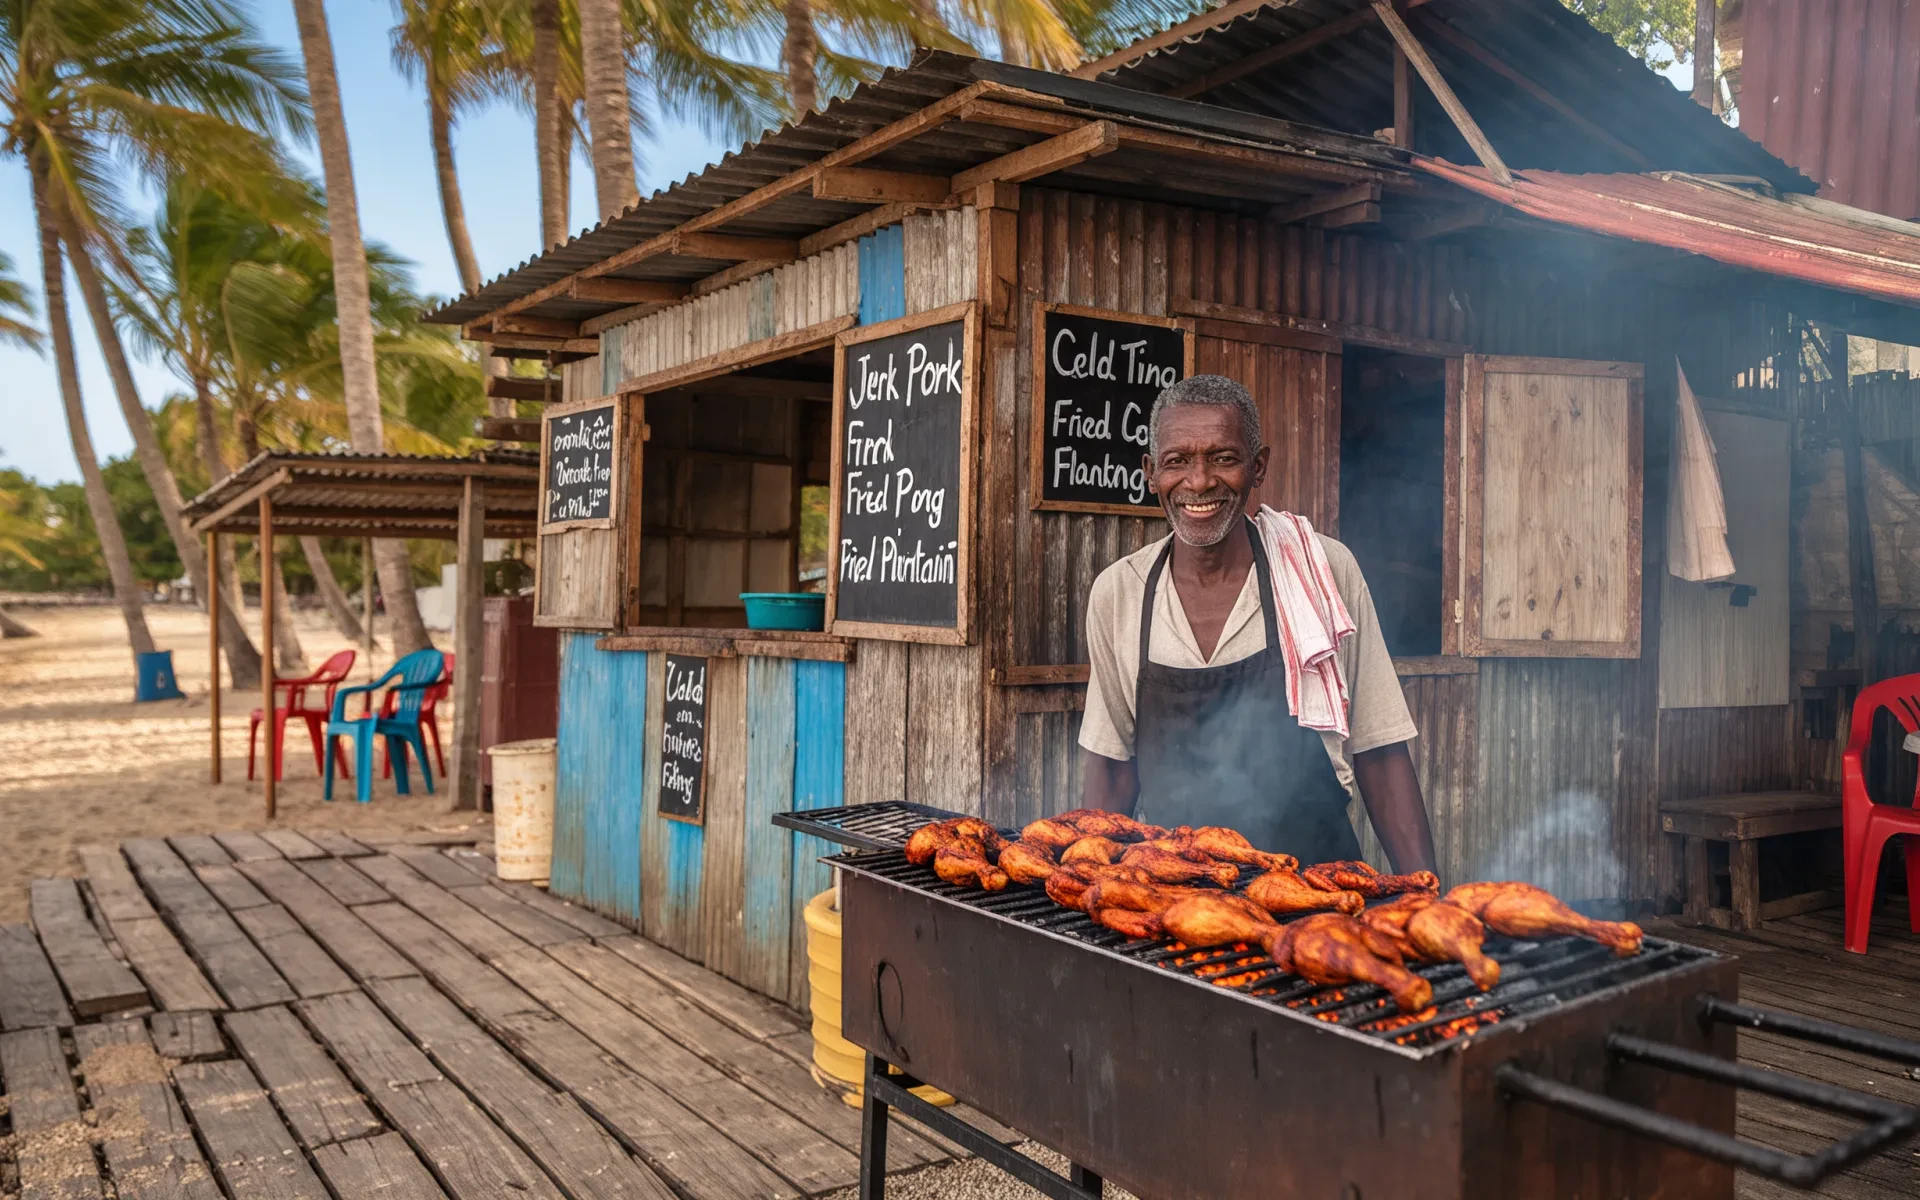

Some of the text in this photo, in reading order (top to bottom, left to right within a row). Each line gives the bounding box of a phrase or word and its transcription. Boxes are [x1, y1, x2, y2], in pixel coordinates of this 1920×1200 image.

[849, 337, 962, 410] Jerk Pork
[1052, 399, 1111, 440] Fried
